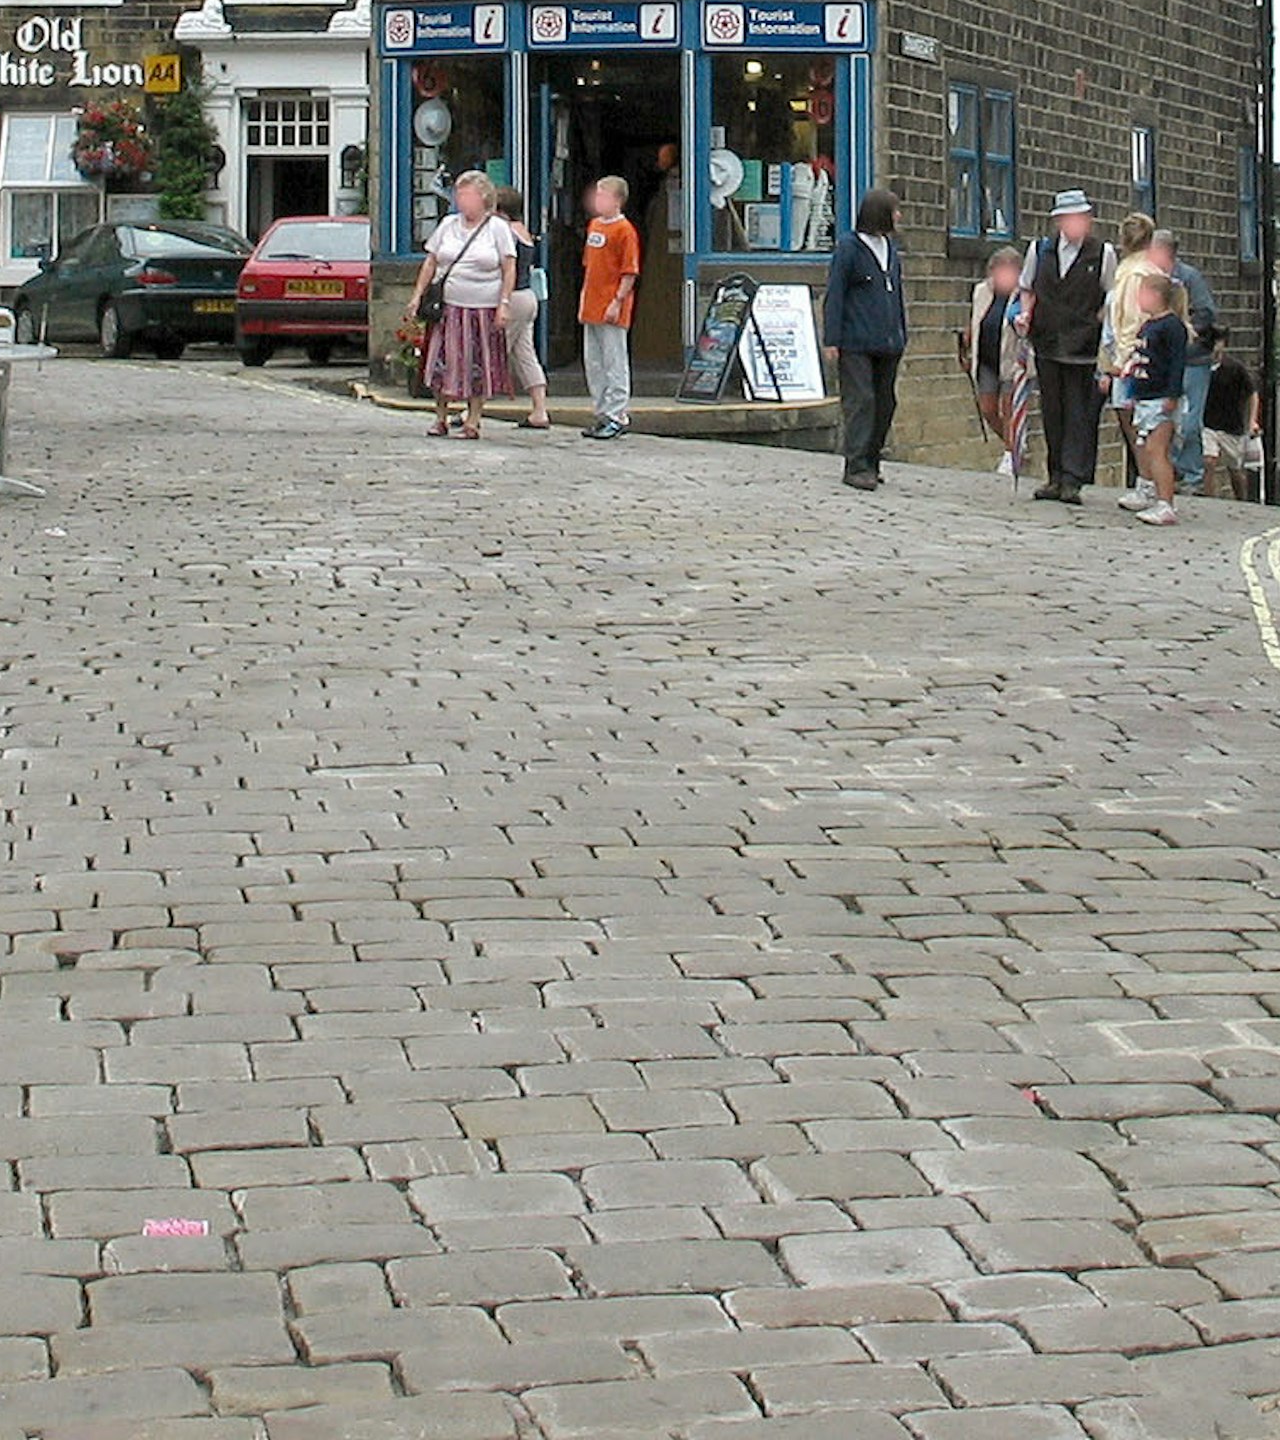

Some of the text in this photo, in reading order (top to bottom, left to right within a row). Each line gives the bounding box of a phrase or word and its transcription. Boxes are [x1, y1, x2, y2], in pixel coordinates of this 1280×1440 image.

[417, 13, 452, 25] Tourist
[572, 9, 613, 22] Tourist
[748, 8, 795, 22] Tourist
[17, 16, 83, 52] Old
[571, 21, 637, 34] Information
[748, 22, 821, 35] Information
[70, 50, 144, 86] Lion
[149, 63, 176, 82] AA
